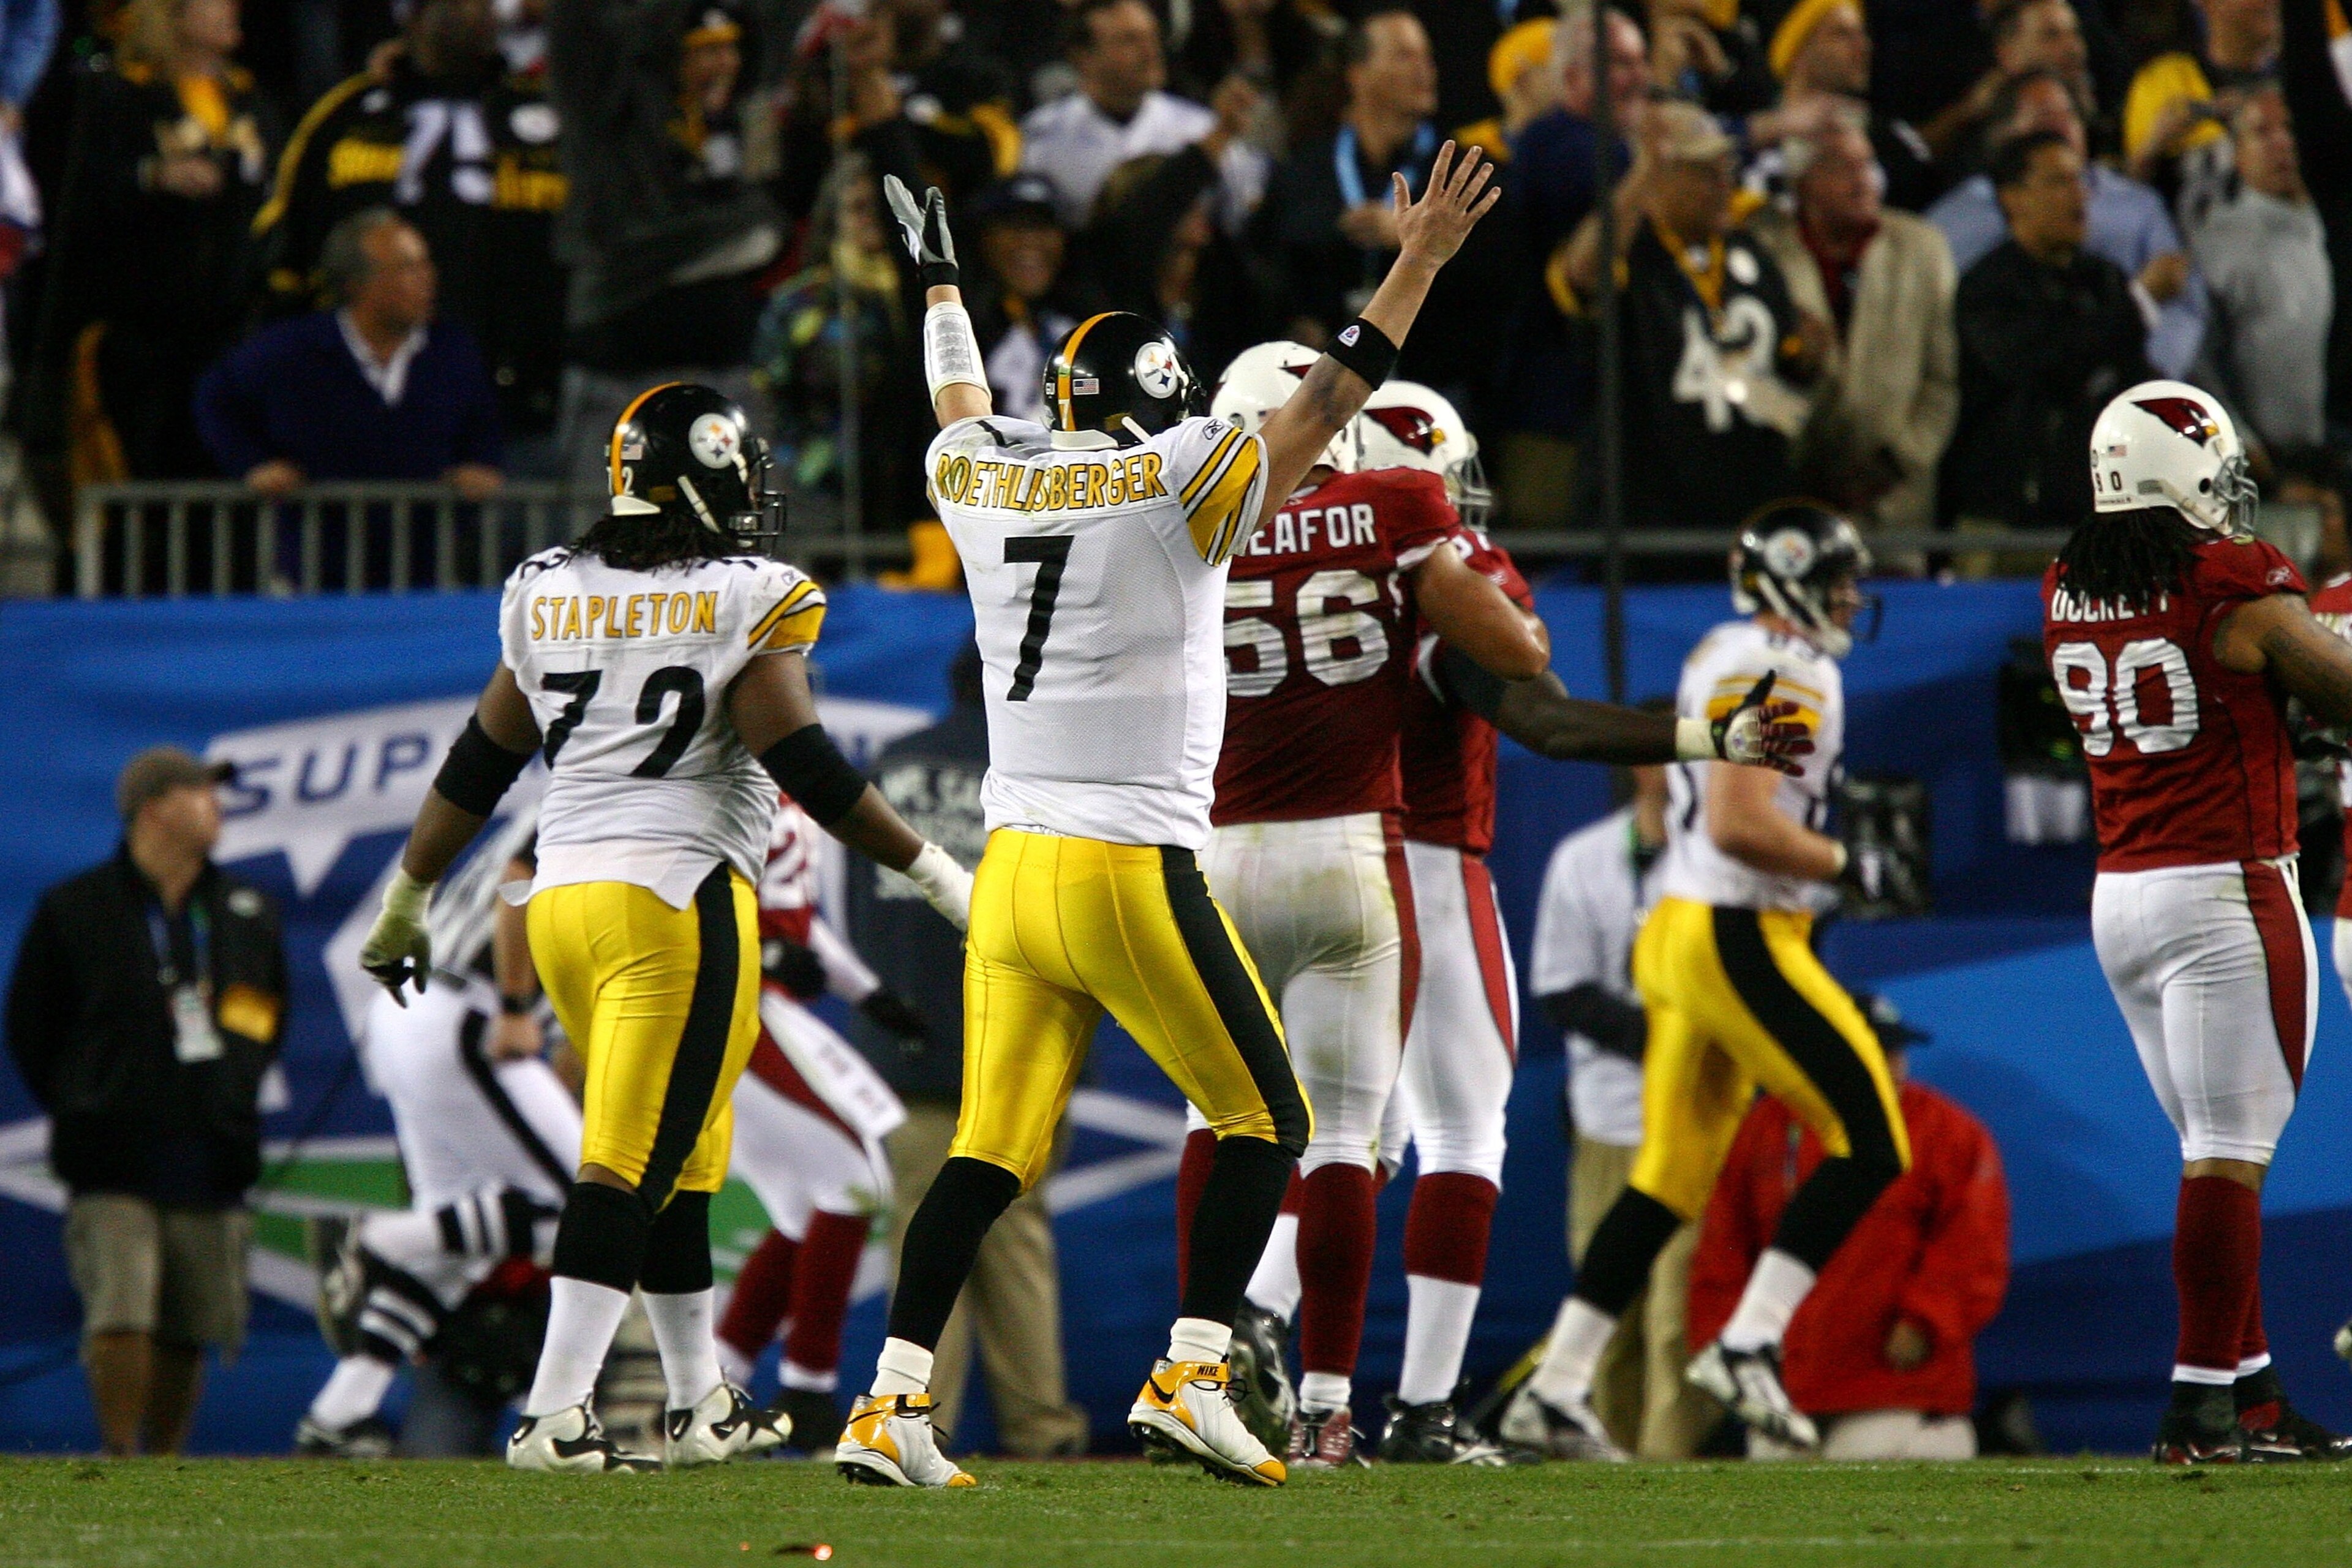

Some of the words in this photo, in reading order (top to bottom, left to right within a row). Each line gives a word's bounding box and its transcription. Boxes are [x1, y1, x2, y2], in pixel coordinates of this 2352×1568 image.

[935, 451, 1169, 512] ROETHLISBERGER
[1242, 503, 1377, 556] EAFOR
[530, 590, 719, 641] STAPLETON
[1004, 535, 1075, 703] 7
[1224, 569, 1390, 698] 56
[540, 665, 705, 779] 72
[2052, 637, 2200, 757] 90
[1197, 1365, 1219, 1376] NIKE
